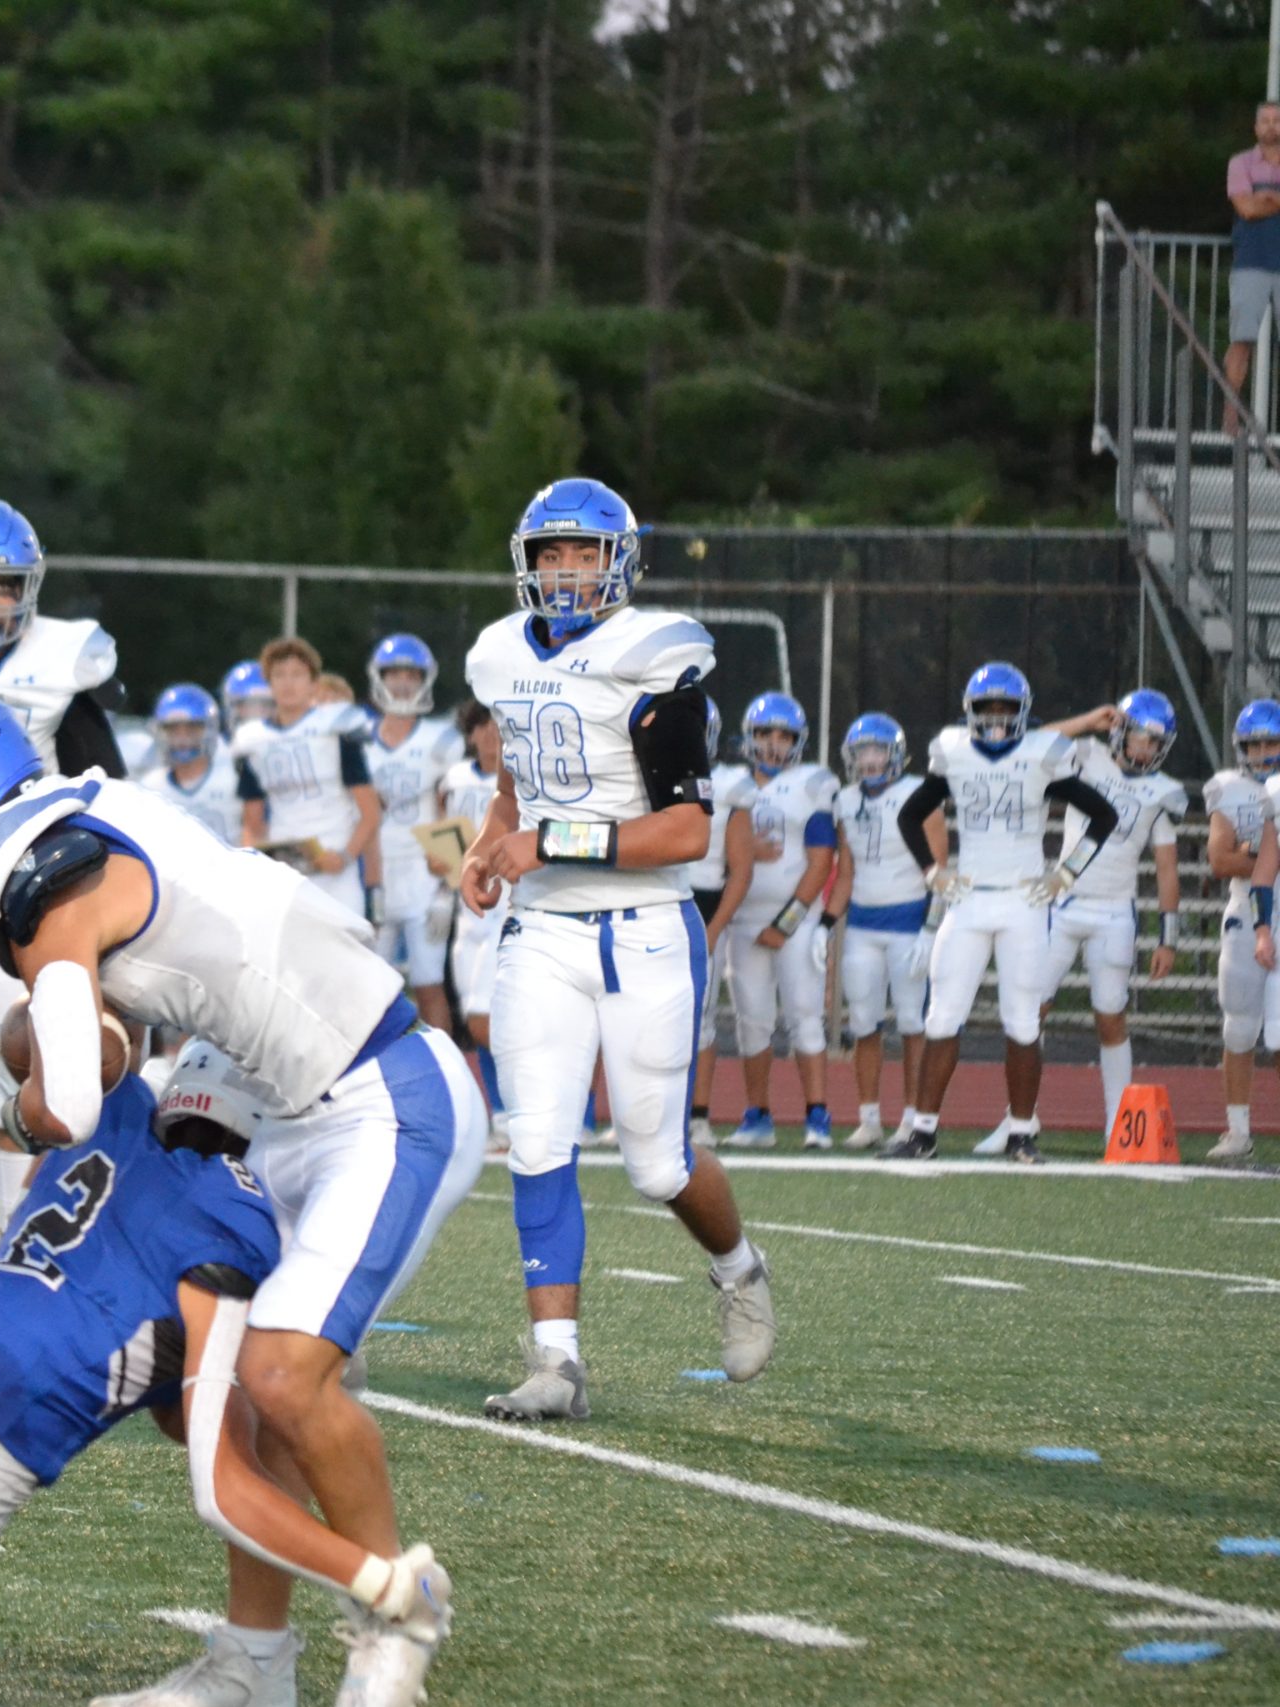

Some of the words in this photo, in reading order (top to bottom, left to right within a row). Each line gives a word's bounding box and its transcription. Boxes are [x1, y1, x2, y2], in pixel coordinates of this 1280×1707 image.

[513, 680, 563, 696] FALCONS
[493, 700, 593, 804] 58
[962, 780, 1024, 833] 24
[1119, 1108, 1146, 1150] 30
